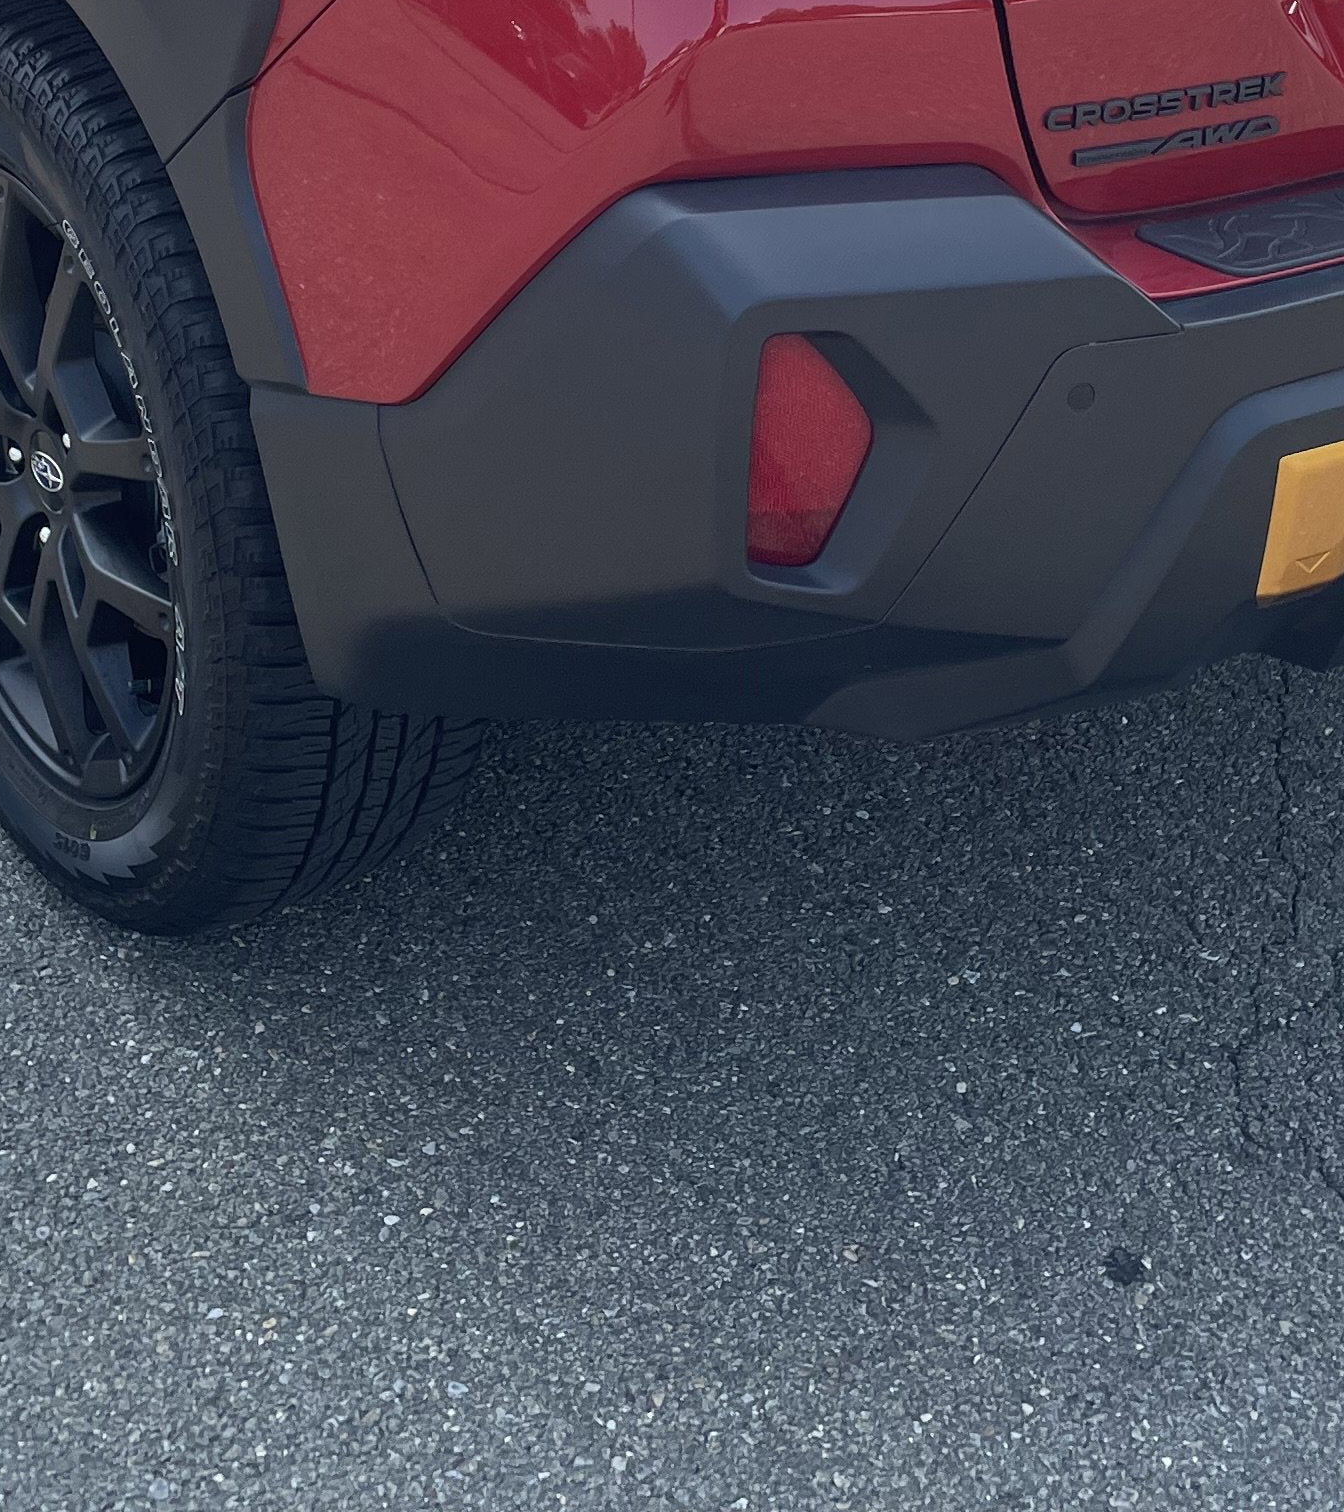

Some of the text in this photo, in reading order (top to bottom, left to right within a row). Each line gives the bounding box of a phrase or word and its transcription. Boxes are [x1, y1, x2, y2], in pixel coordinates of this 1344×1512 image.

[1044, 71, 1288, 132] CROSSTREK
[1152, 115, 1281, 157] AWD
[62, 219, 178, 566] GEOLANDAR
